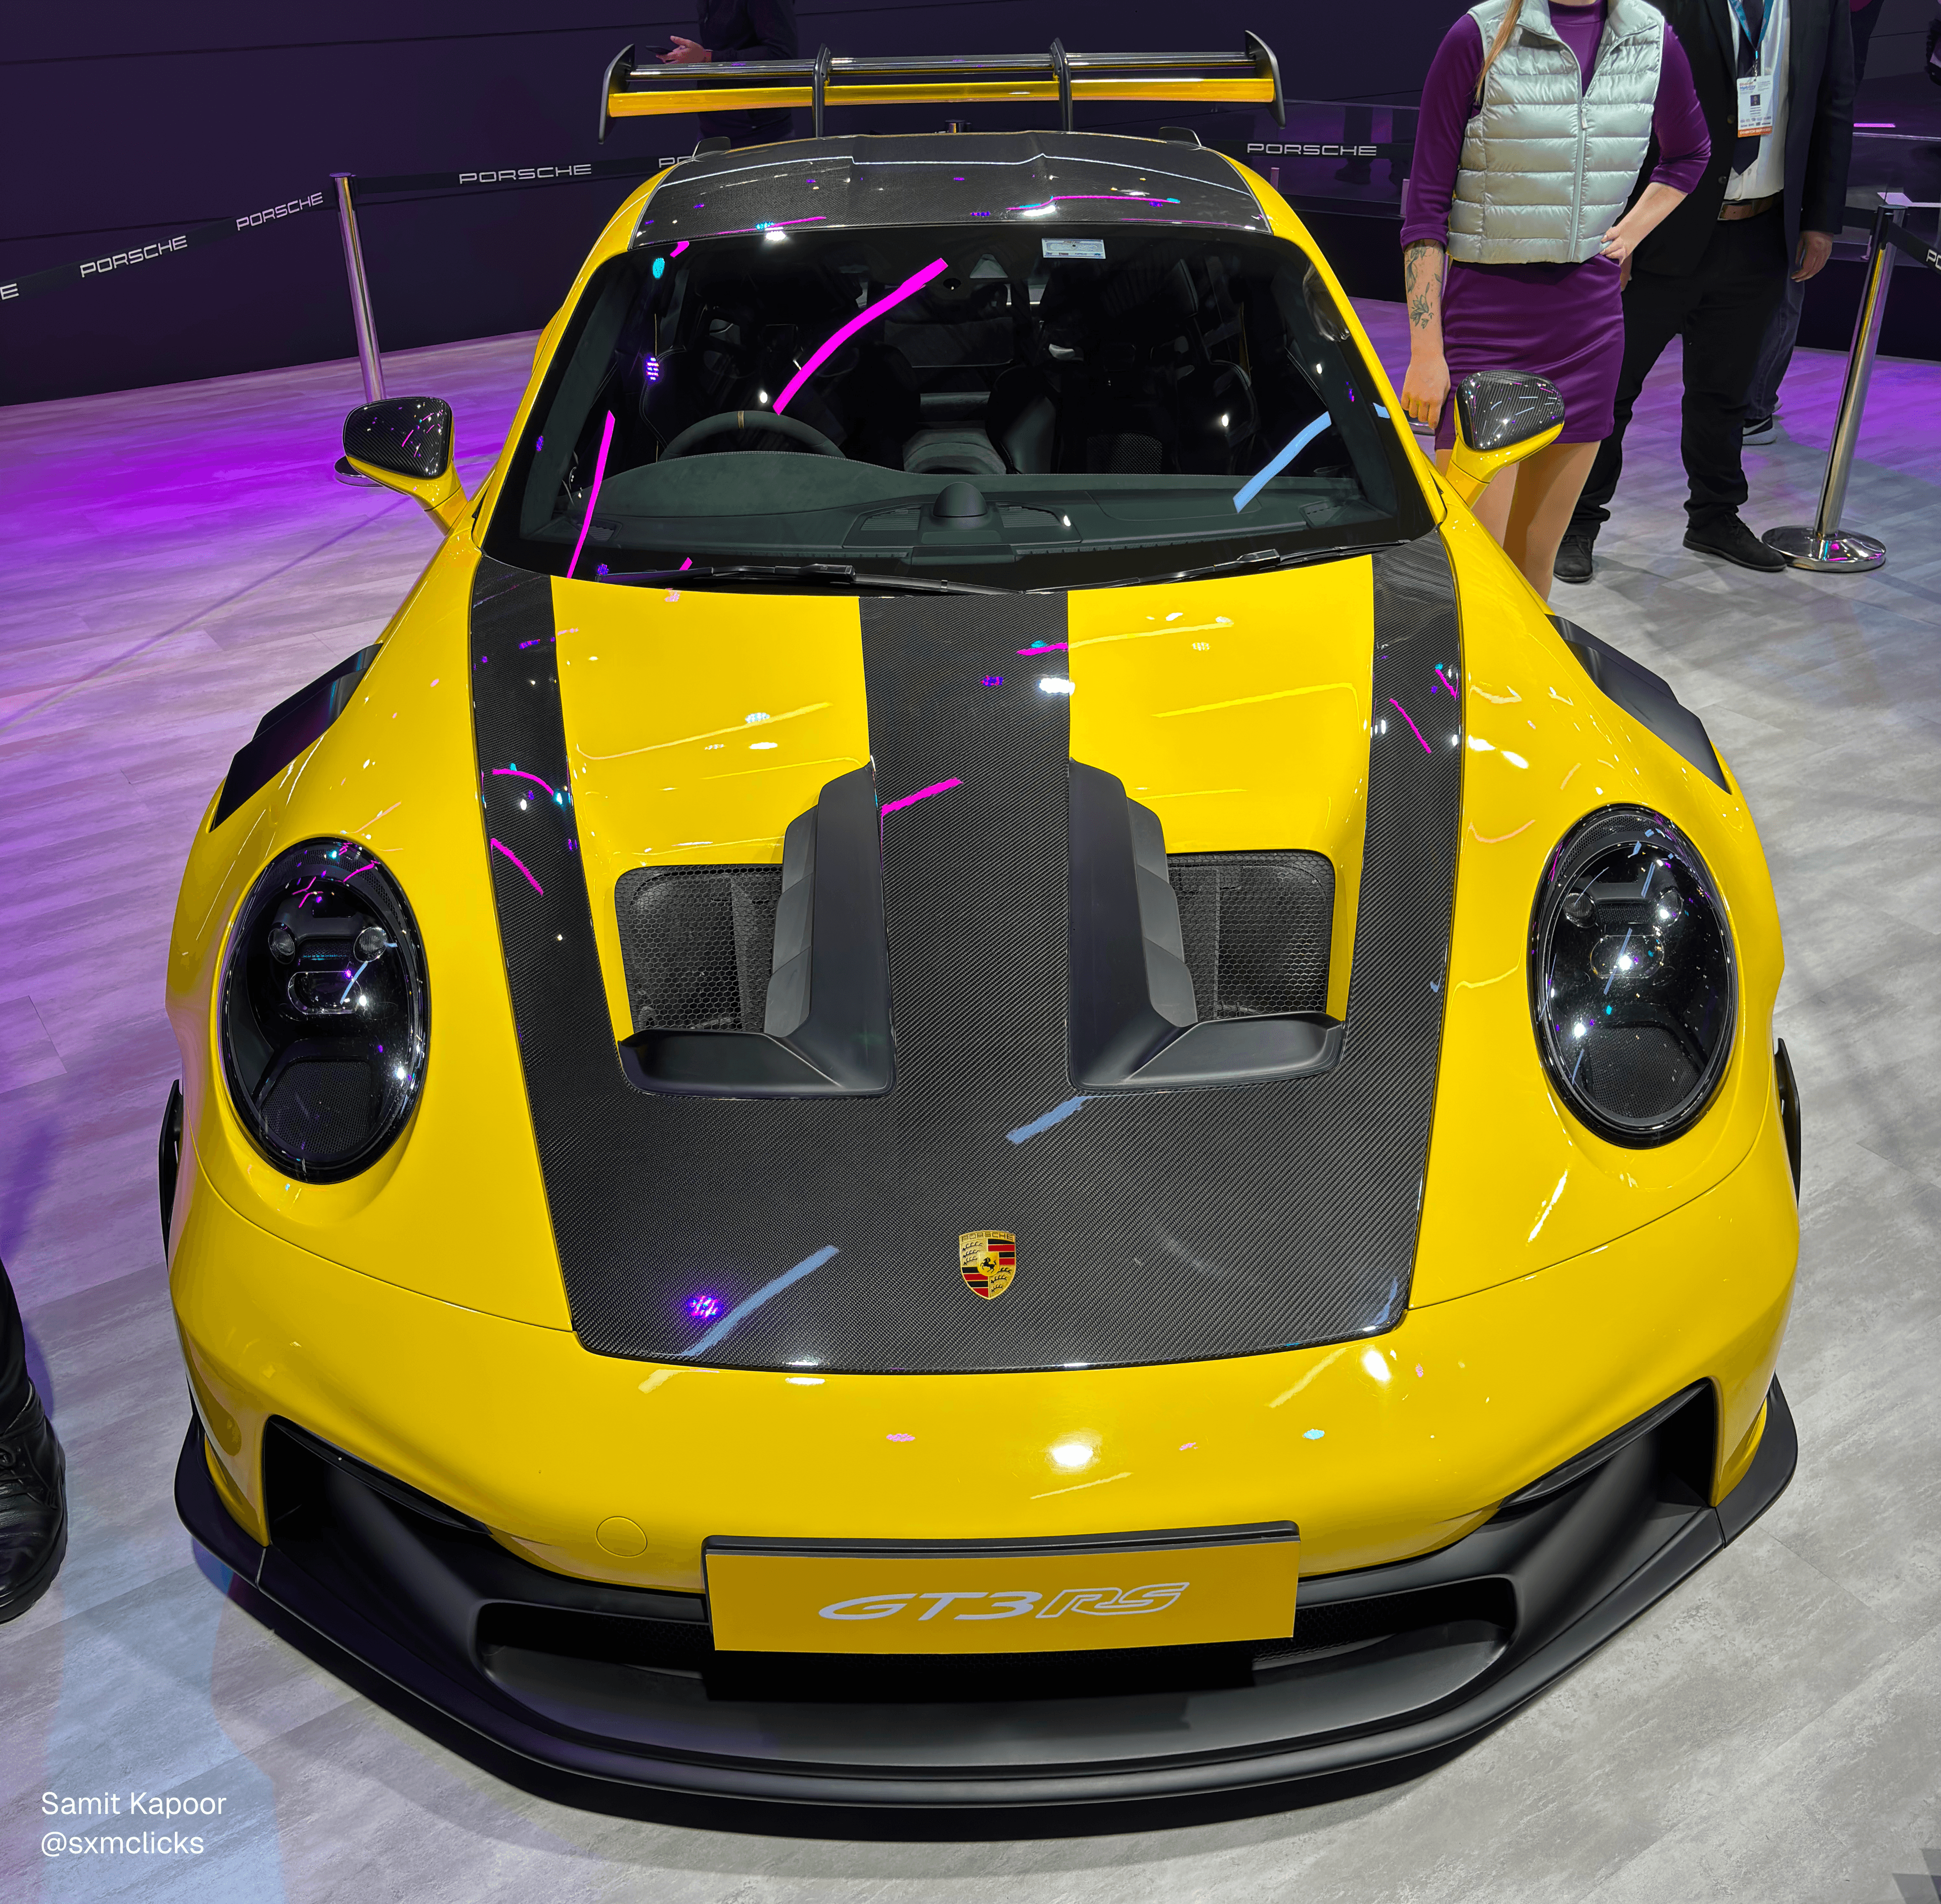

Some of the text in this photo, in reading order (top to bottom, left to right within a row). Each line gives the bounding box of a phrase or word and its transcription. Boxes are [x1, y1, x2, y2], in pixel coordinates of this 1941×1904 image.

[1247, 143, 1377, 156] PORSCHE
[459, 164, 592, 184] PORSCHE
[236, 192, 324, 231] PORSCHE
[79, 235, 188, 278] PORSCHE
[961, 1232, 1014, 1242] PORSCHE
[818, 1582, 1190, 1621] GT3 RS
